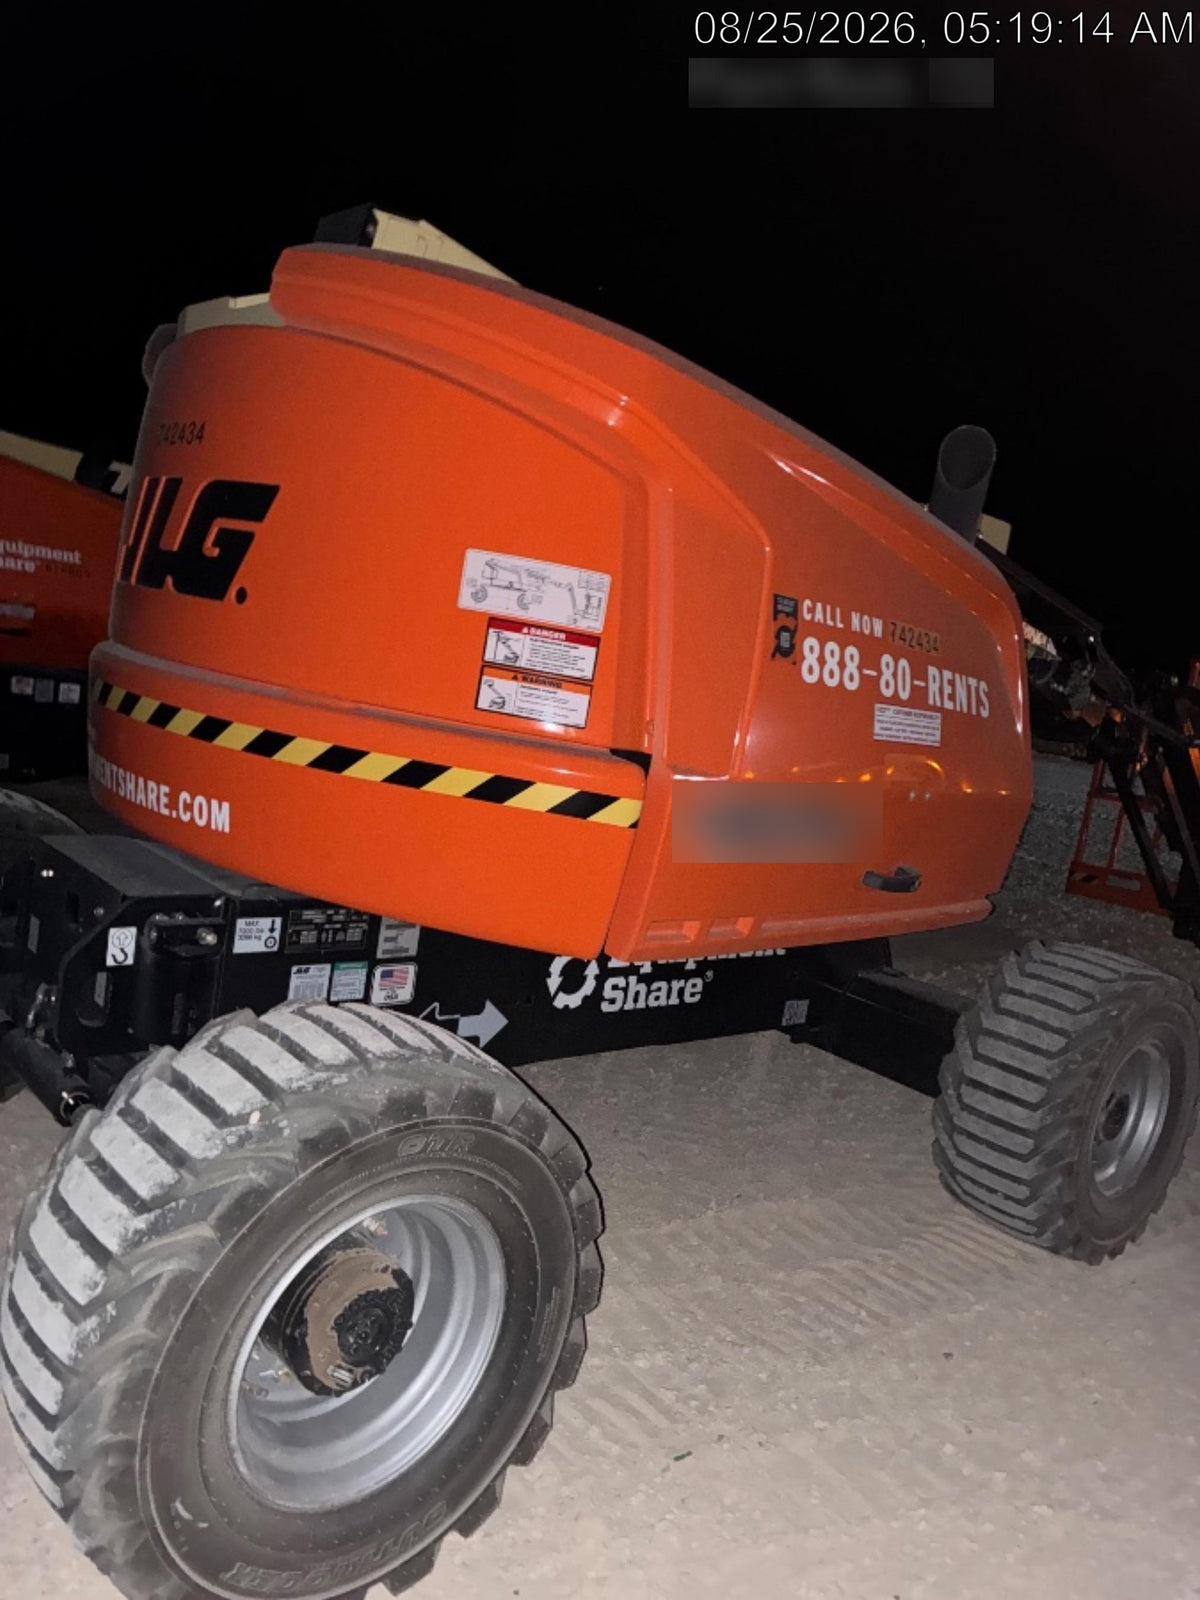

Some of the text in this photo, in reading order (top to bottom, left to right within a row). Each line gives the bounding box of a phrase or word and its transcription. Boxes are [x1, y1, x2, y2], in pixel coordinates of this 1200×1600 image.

[530, 627, 567, 641] DANGER
[803, 599, 844, 628] CALL
[851, 611, 883, 639] NOW
[890, 621, 939, 655] 742434
[801, 636, 989, 718] 888-80-RENTS
